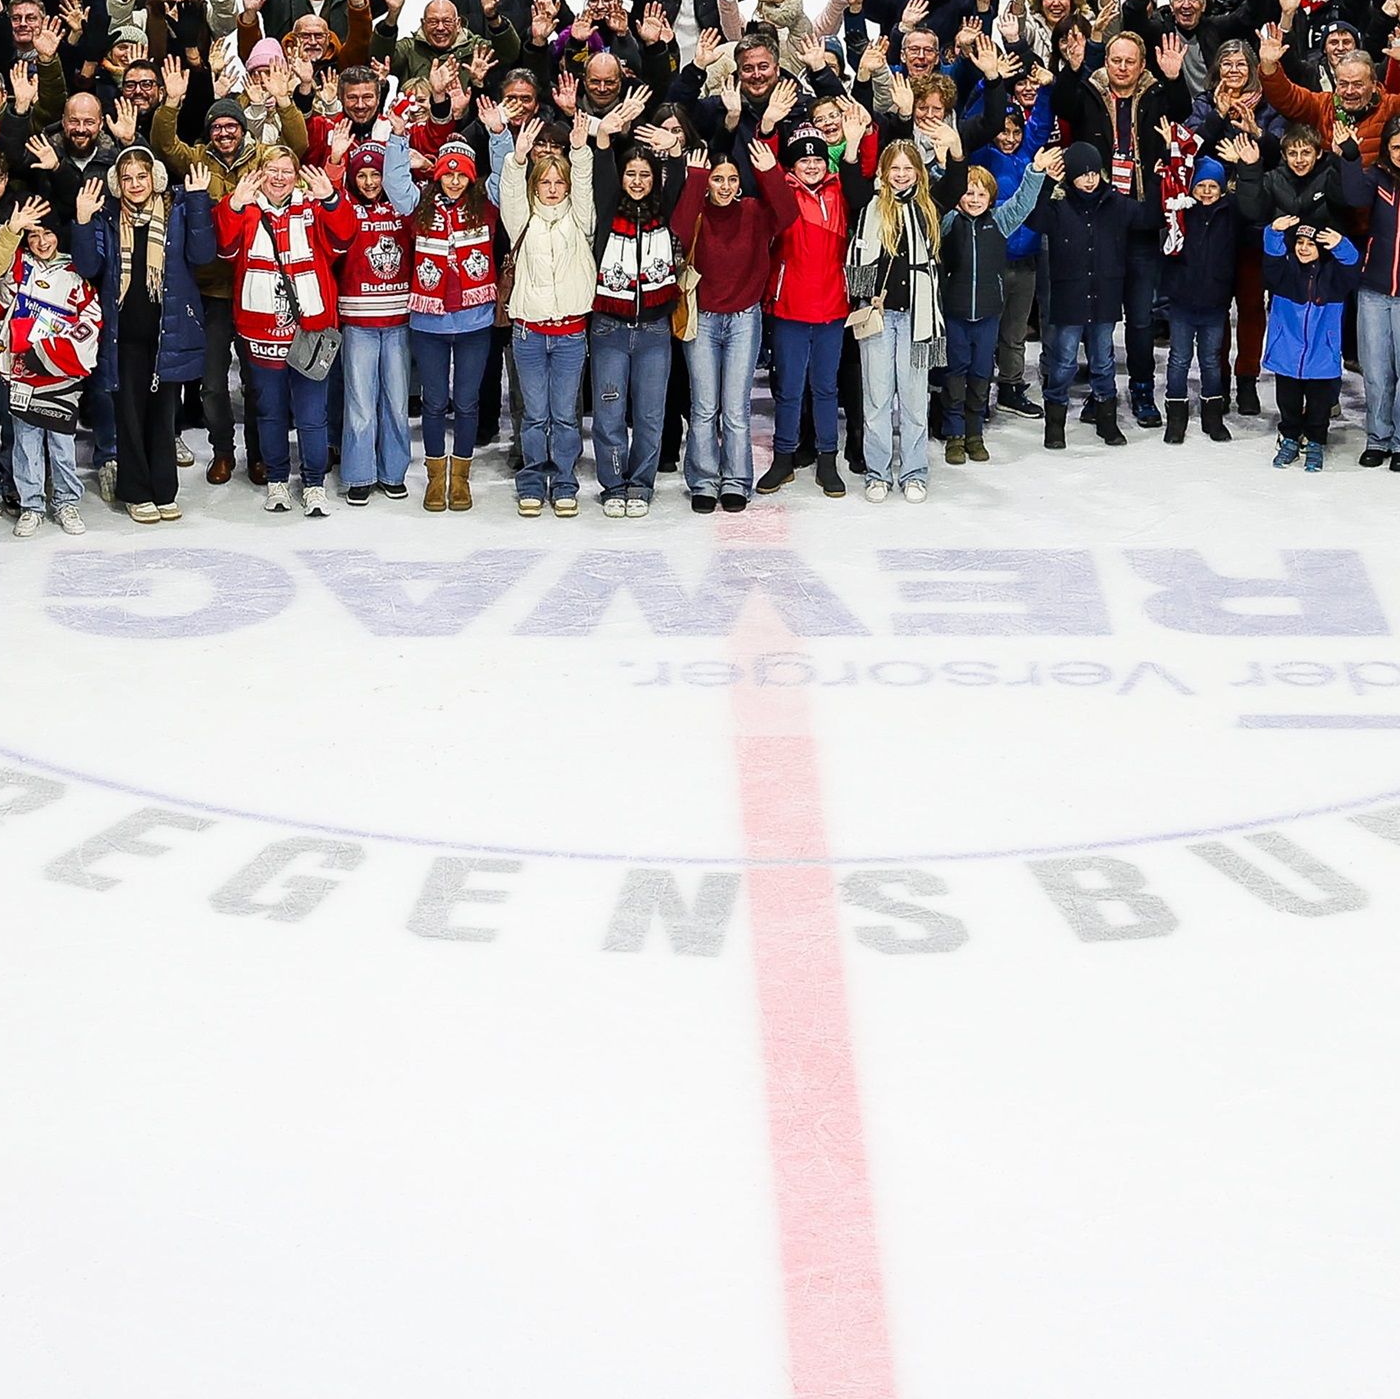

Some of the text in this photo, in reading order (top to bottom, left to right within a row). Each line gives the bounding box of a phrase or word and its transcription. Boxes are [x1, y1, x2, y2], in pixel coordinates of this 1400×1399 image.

[361, 282, 410, 292] Buderus
[250, 341, 289, 356] Bude
[37, 545, 1390, 640] REWAG
[620, 653, 1198, 696] Versorger.
